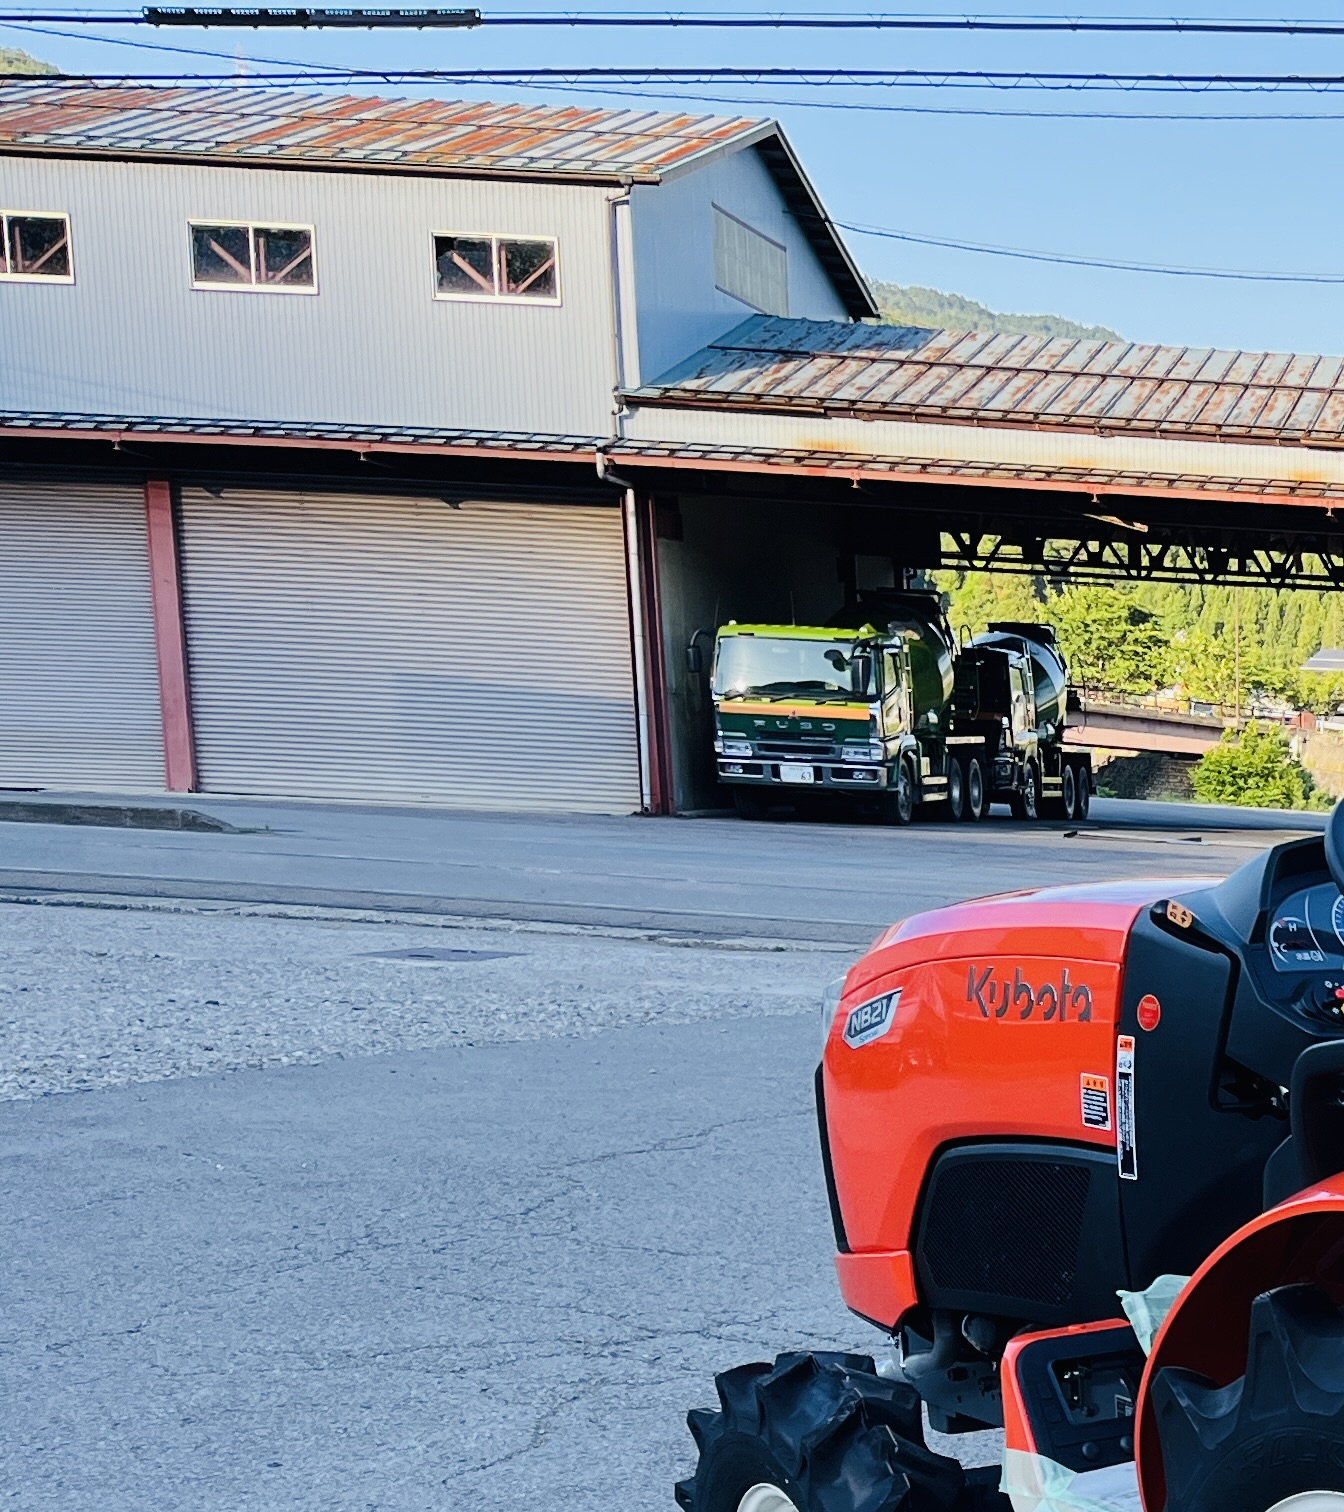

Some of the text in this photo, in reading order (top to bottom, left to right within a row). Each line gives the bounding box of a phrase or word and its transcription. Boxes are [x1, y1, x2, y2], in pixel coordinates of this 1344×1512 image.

[1288, 922, 1298, 933] H
[1280, 943, 1289, 953] C
[966, 964, 1093, 1022] Kubota
[850, 998, 888, 1036] NB21
